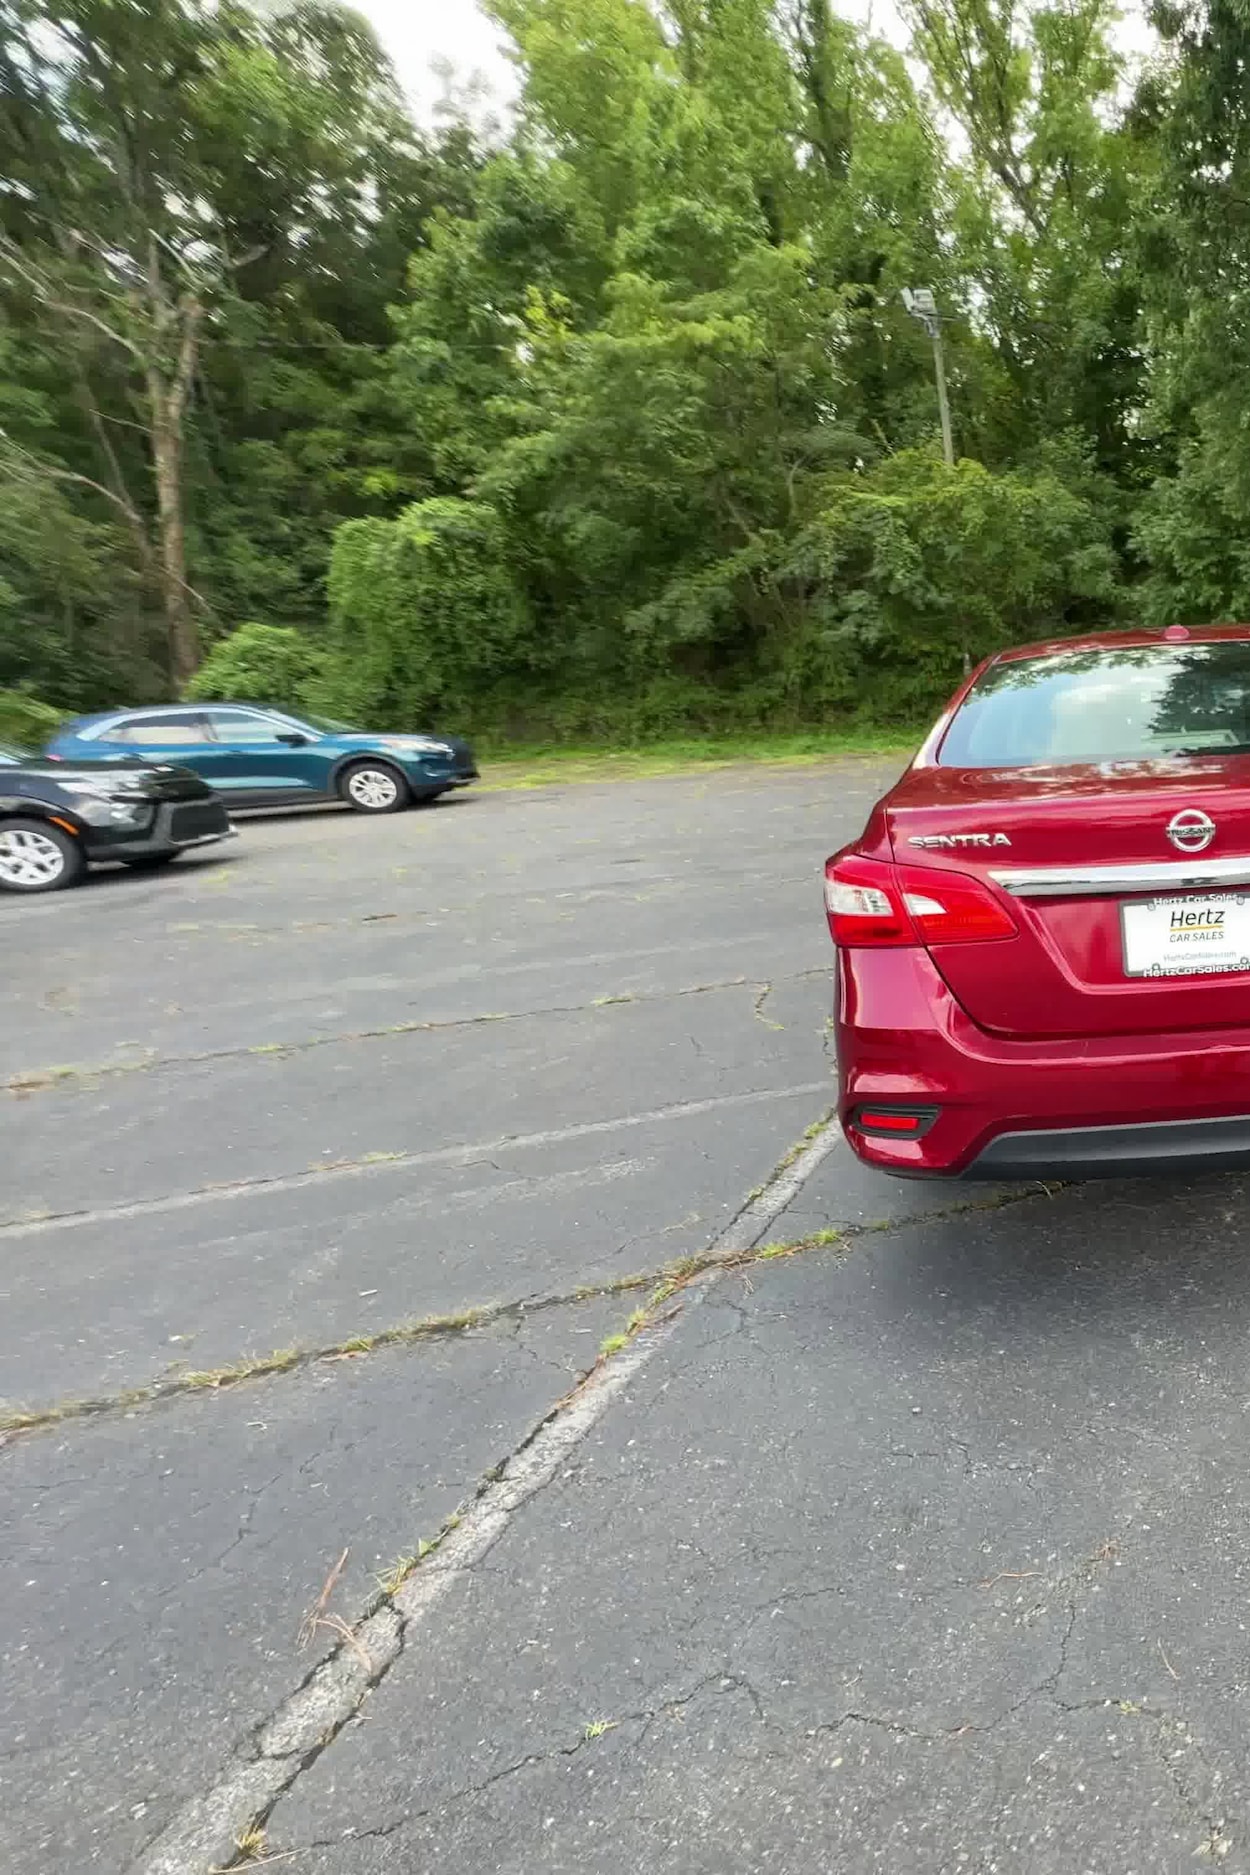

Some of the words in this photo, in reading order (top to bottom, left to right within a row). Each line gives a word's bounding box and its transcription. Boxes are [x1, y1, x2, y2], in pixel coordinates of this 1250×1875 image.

[907, 832, 1012, 848] SENTRA
[1153, 896, 1183, 906] Hertz
[1186, 894, 1206, 904] Car
[1209, 893, 1238, 903] Sales
[1170, 908, 1226, 927] Hertz
[1169, 933, 1191, 943] CAR
[1192, 931, 1225, 942] SALES
